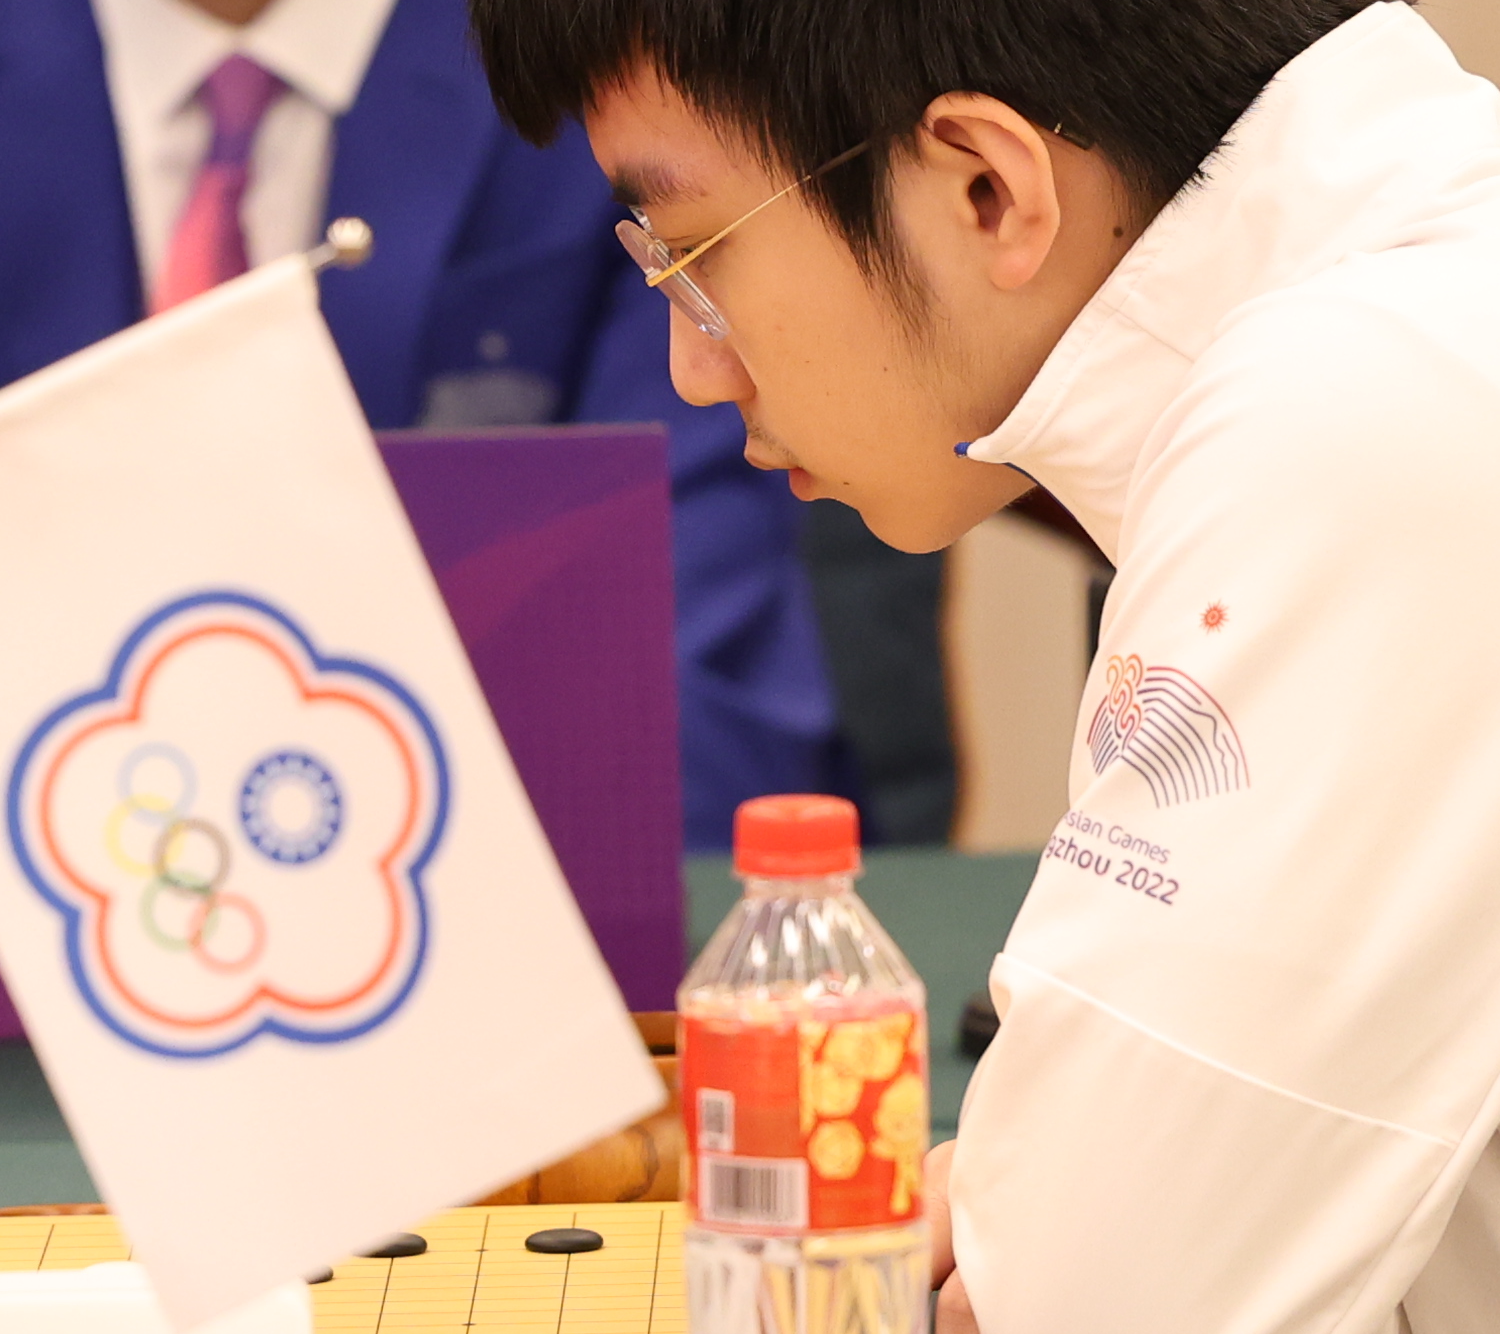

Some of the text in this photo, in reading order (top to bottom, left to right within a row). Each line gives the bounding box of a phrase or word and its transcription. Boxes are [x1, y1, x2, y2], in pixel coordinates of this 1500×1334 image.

[1064, 809, 1171, 864] sian Games
[1115, 860, 1180, 906] 2022
